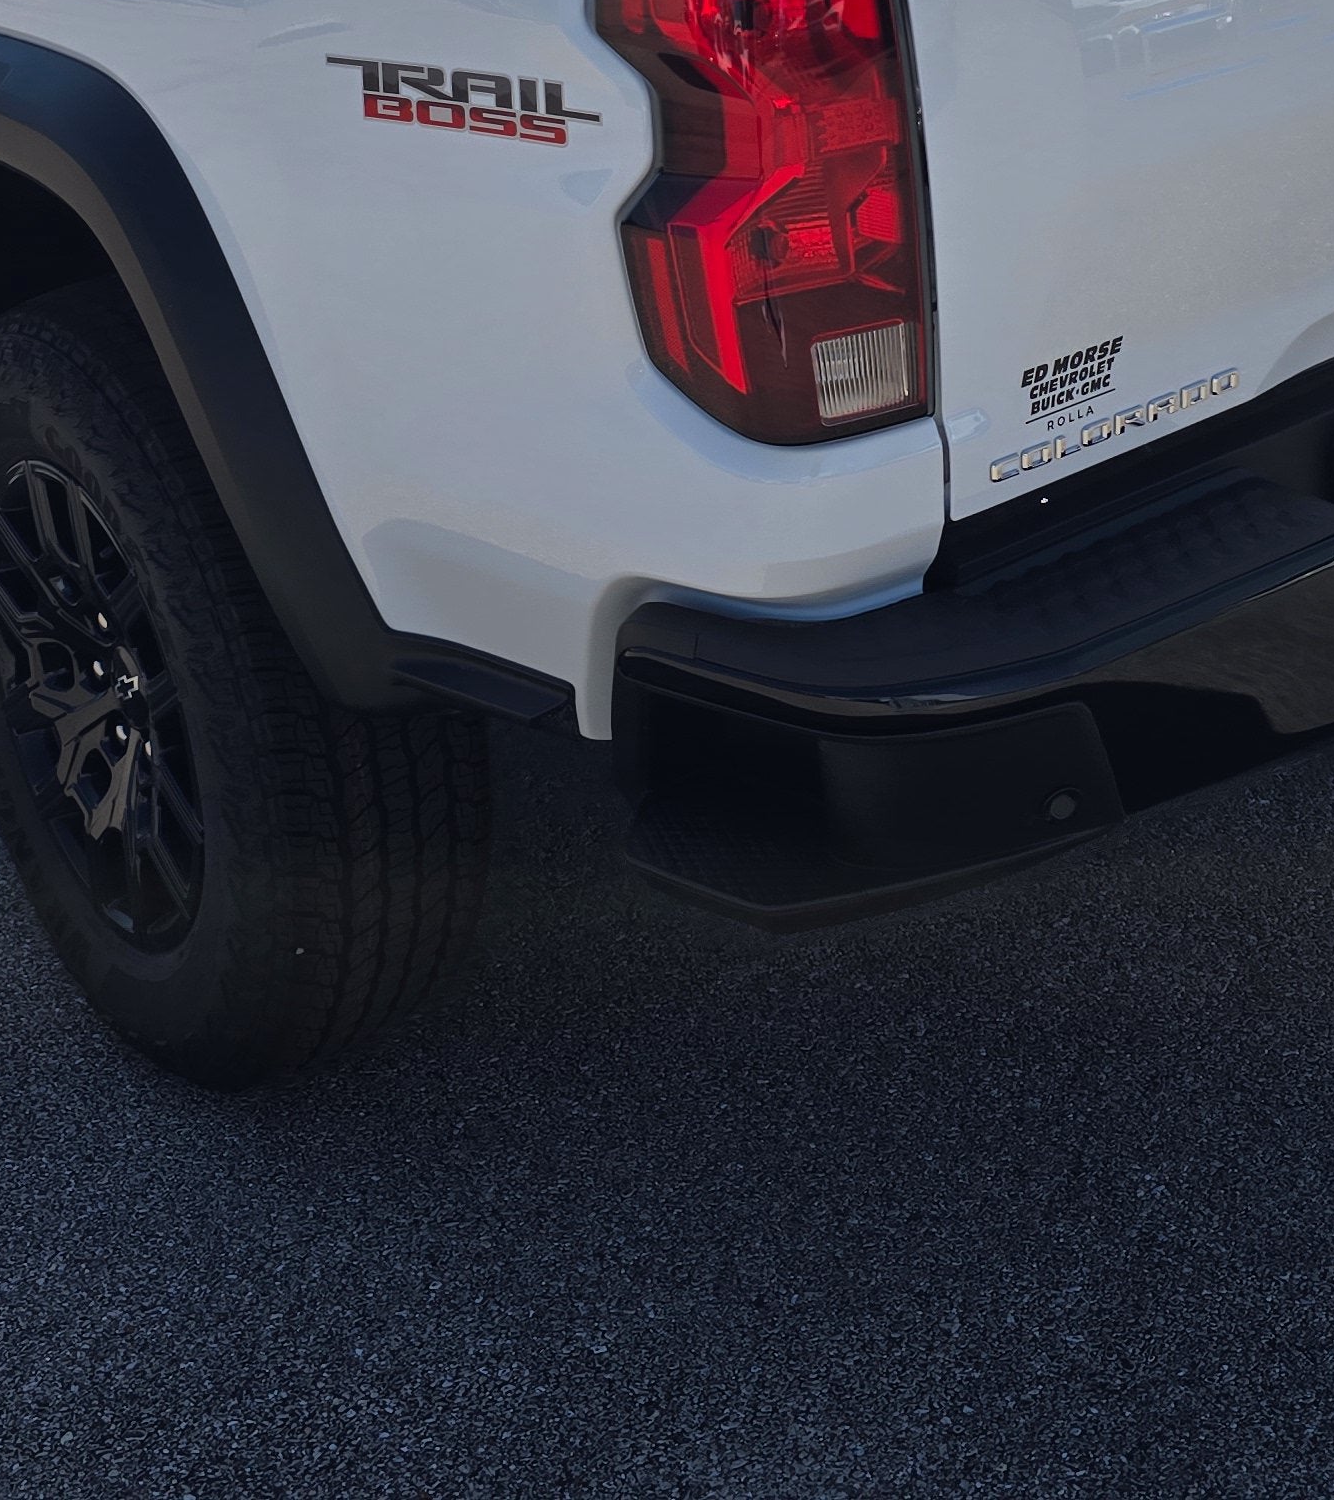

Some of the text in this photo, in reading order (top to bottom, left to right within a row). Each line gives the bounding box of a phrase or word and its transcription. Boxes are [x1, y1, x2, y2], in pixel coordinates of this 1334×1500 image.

[326, 53, 603, 126] TRAIL
[363, 92, 568, 147] BOSS
[1020, 335, 1124, 389] ED MORSE
[1029, 356, 1116, 400] CHEVROLET
[989, 367, 1240, 483] COLORADO
[1047, 405, 1095, 432] ROLLA
